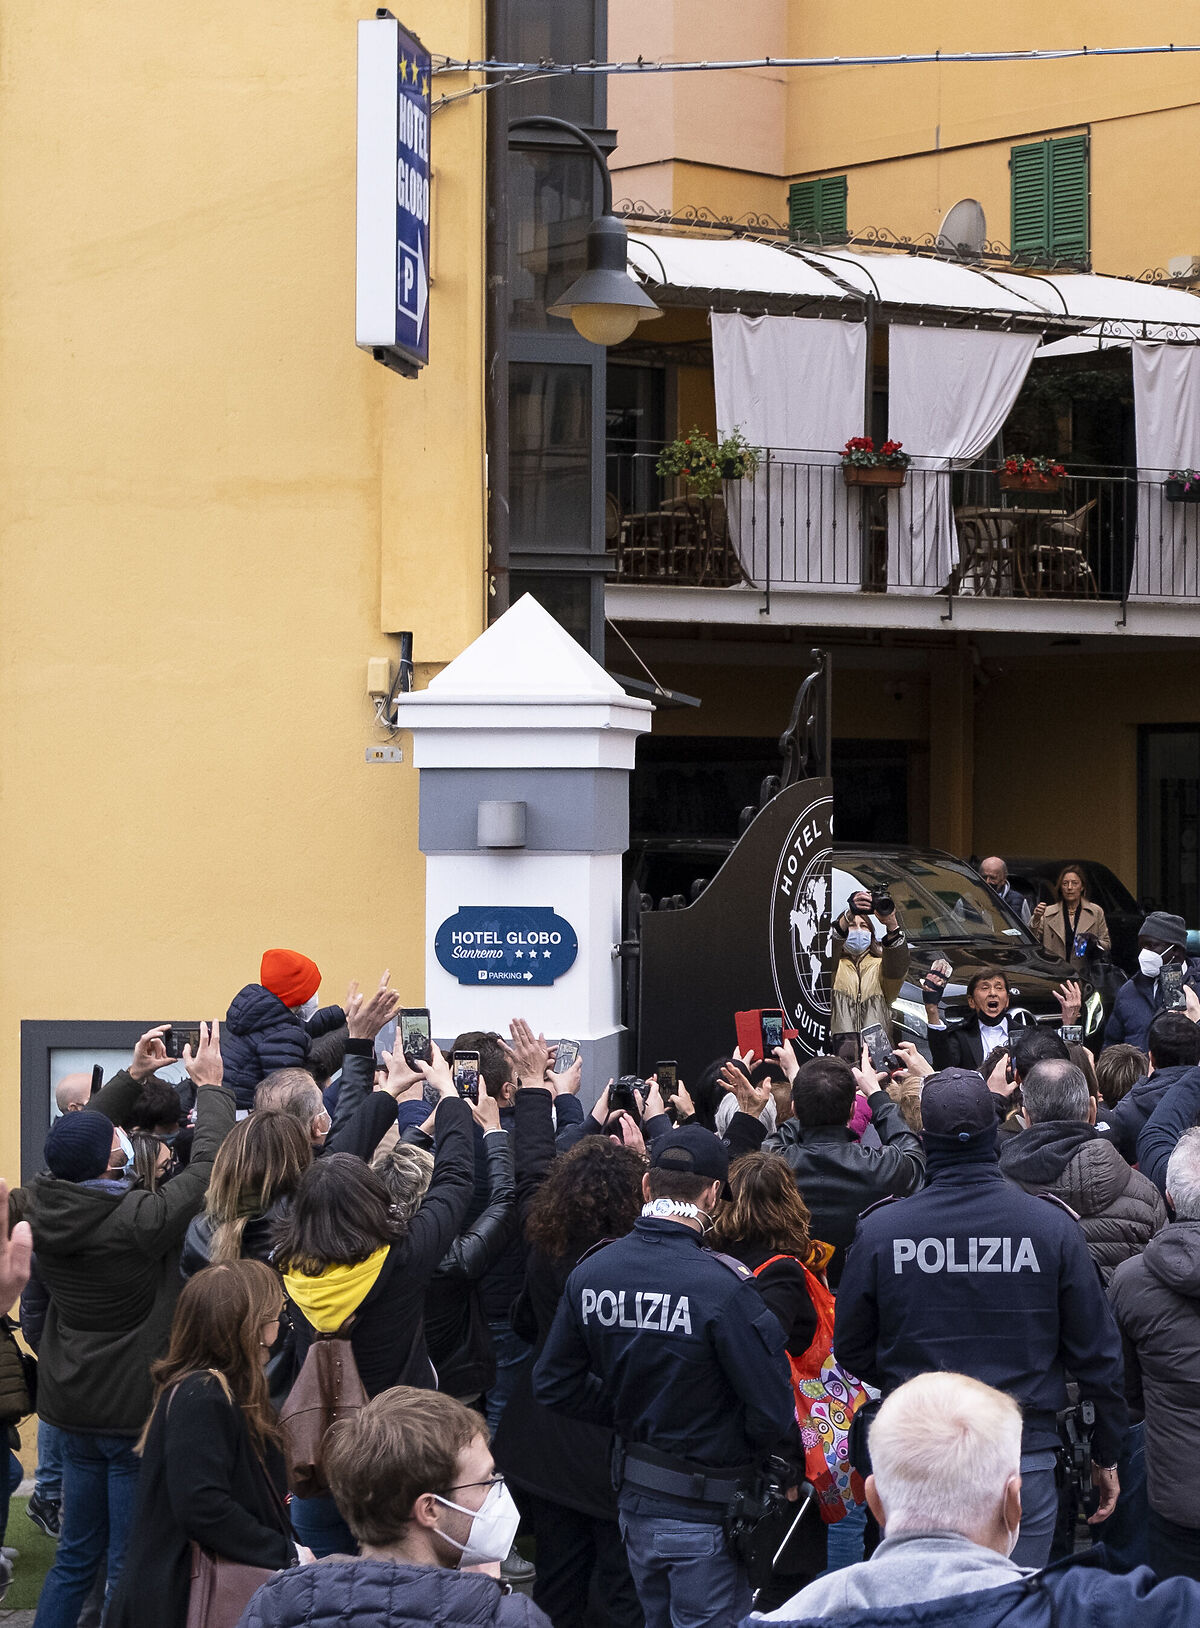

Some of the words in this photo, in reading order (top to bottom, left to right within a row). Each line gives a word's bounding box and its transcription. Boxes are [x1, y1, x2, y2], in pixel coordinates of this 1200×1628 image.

[400, 92, 428, 163] HOTEL
[398, 157, 429, 226] GLOBO
[404, 256, 414, 303] P
[781, 819, 822, 896] HOTEL
[451, 945, 504, 959] Sanremo
[452, 931, 503, 945] HOTEL
[506, 931, 562, 945] GLOBO
[488, 972, 522, 980] PARKING
[794, 1003, 826, 1041] SUITE
[893, 1237, 1041, 1274] POLIZIA
[581, 1288, 693, 1335] POLIZIA
